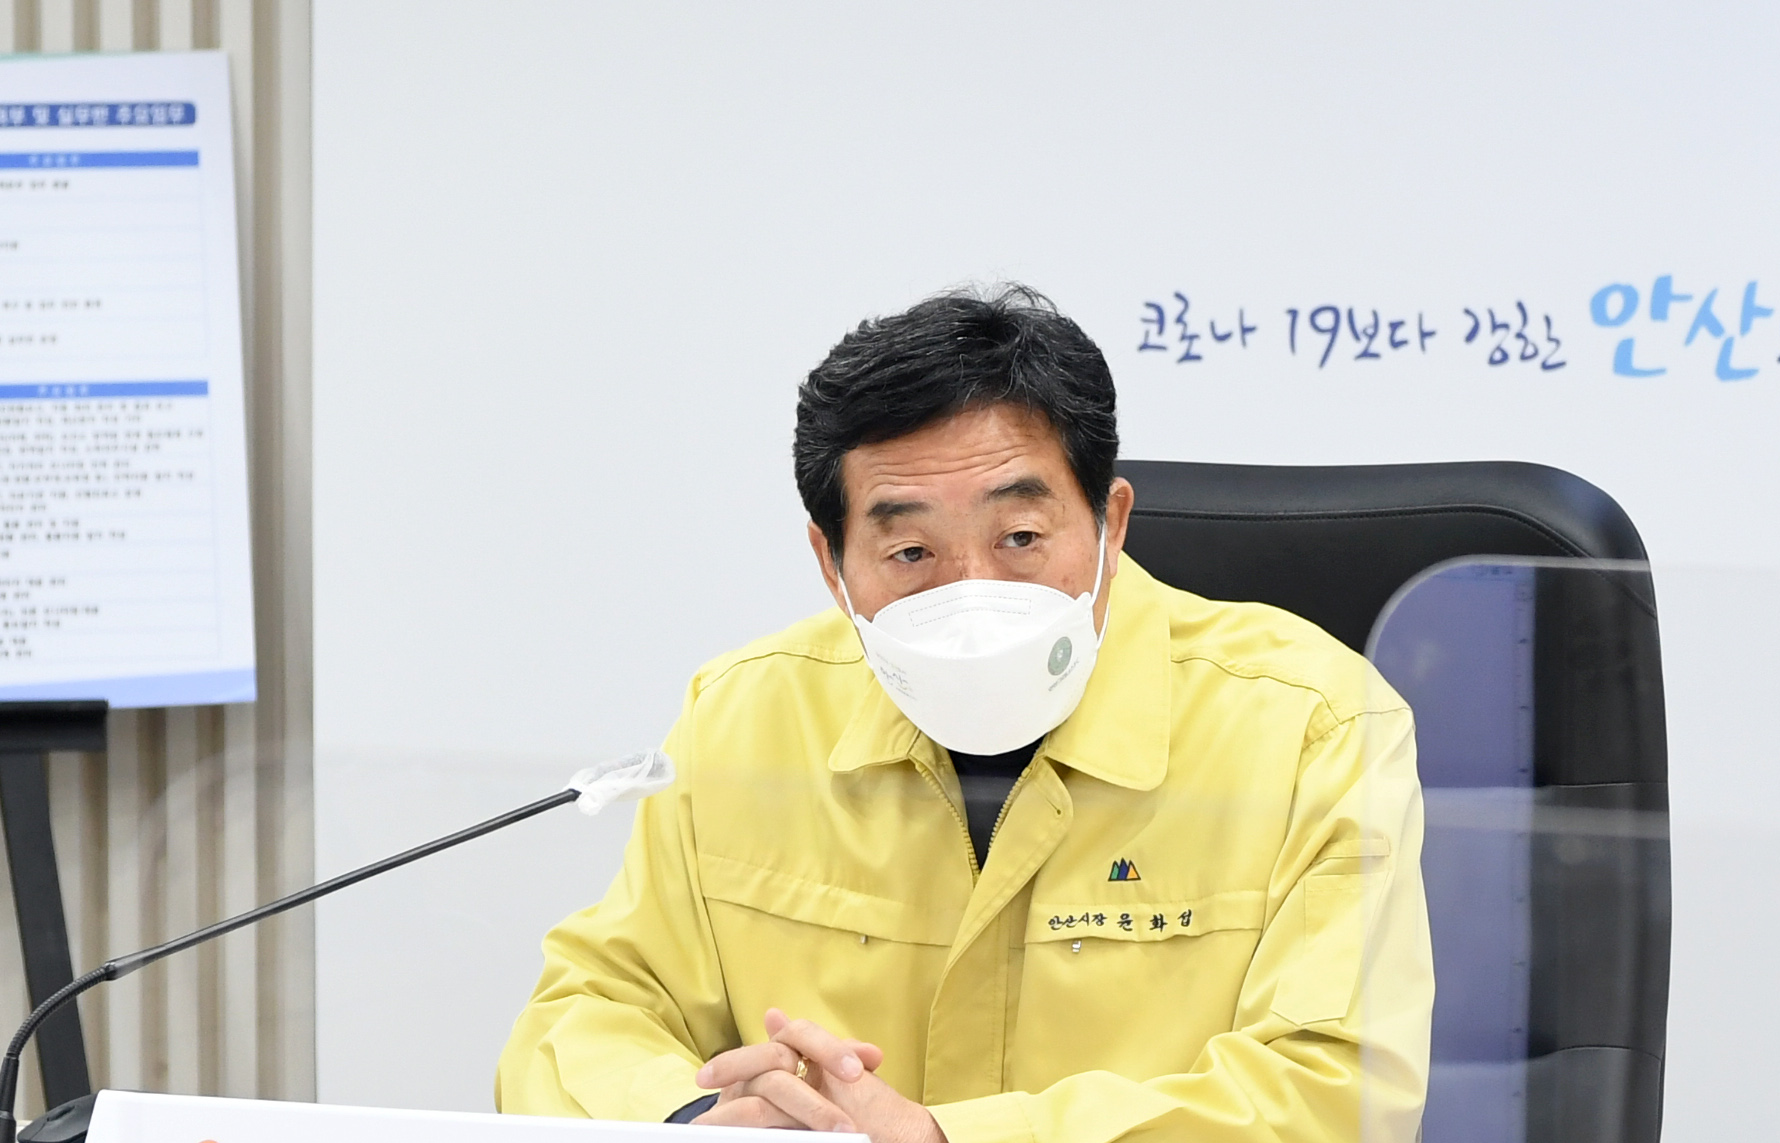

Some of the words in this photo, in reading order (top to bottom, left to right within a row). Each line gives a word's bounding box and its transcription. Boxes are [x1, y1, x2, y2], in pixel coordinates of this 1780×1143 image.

[1136, 292, 1257, 363] 코로나
[1284, 304, 1437, 370] 19보다
[1462, 301, 1568, 371] 강한
[1047, 911, 1108, 932] 안산시장
